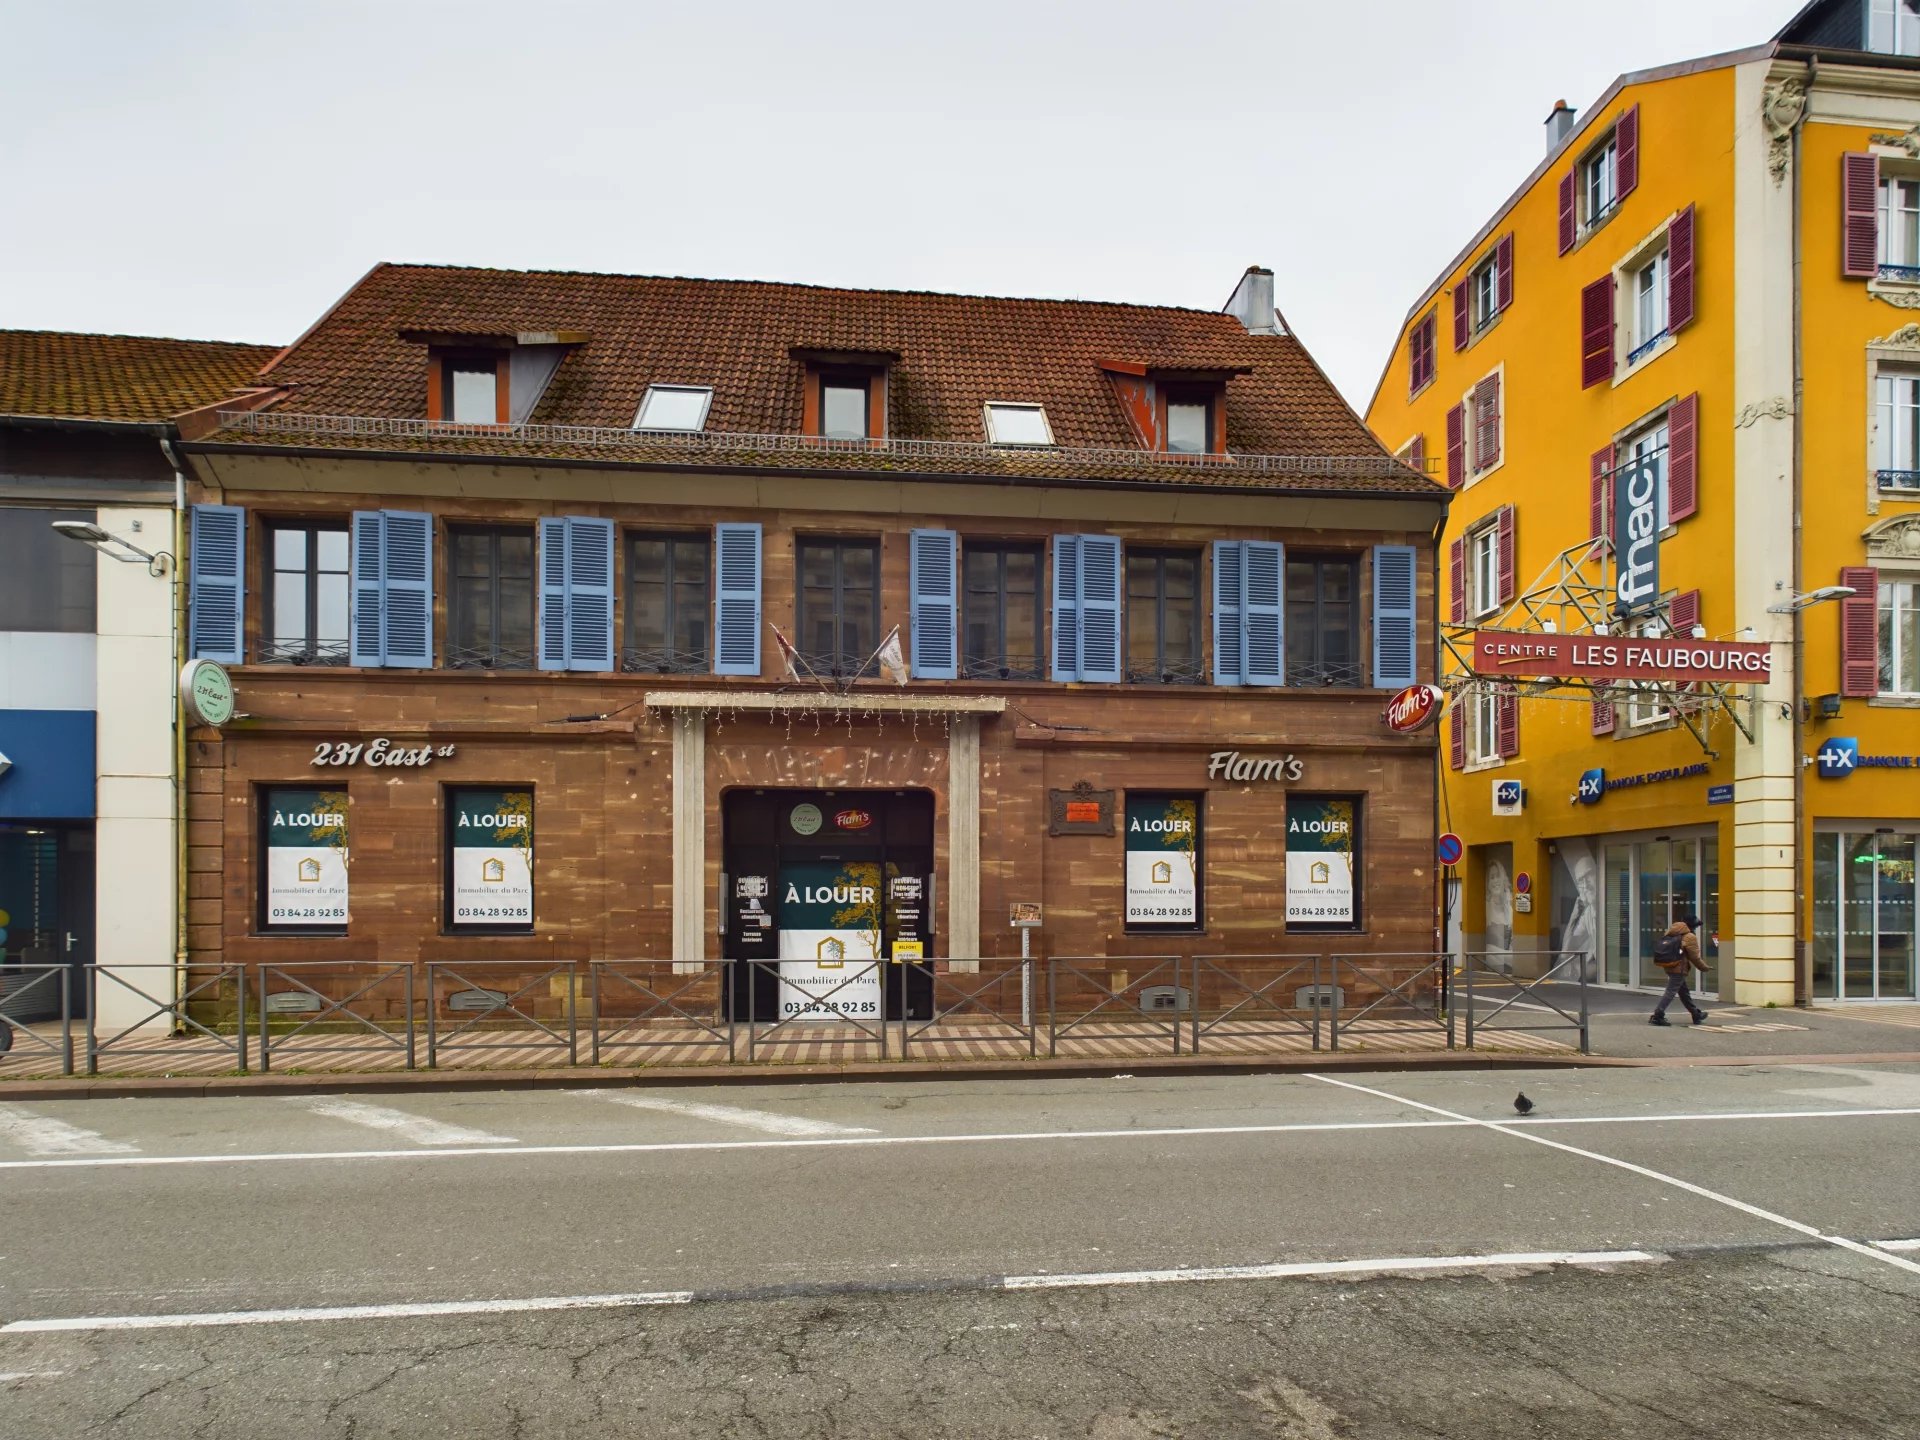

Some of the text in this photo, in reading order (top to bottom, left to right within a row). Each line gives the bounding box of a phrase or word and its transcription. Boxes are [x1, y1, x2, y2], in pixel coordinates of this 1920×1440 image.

[1618, 468, 1653, 603] fnac
[1484, 644, 1771, 671] CENTRE LES FAUBOURGS
[1388, 686, 1429, 728] Flam's
[310, 738, 455, 766] 231 East st
[1208, 752, 1304, 781] Flam's
[1857, 755, 1911, 768] BANQUE
[1606, 774, 1644, 790] BANQUE
[1646, 762, 1708, 783] POPULAIRE
[273, 810, 344, 826] À LOUER
[458, 811, 527, 827] À LOUER
[837, 811, 869, 826] Flam's
[1130, 817, 1191, 832] À LOUER
[1289, 818, 1348, 833] À LOUER
[785, 882, 876, 904] À LOUER
[273, 908, 345, 917] 03 84 28 92 85
[458, 908, 528, 917] 03 84 28 92 85
[1130, 907, 1192, 916] 03 84 28 92 85
[1289, 907, 1349, 916] 03 84 28 92 85
[784, 976, 838, 985] Immobilier
[857, 976, 876, 985] Parc
[784, 1002, 876, 1013] 03 84 28 92 85
